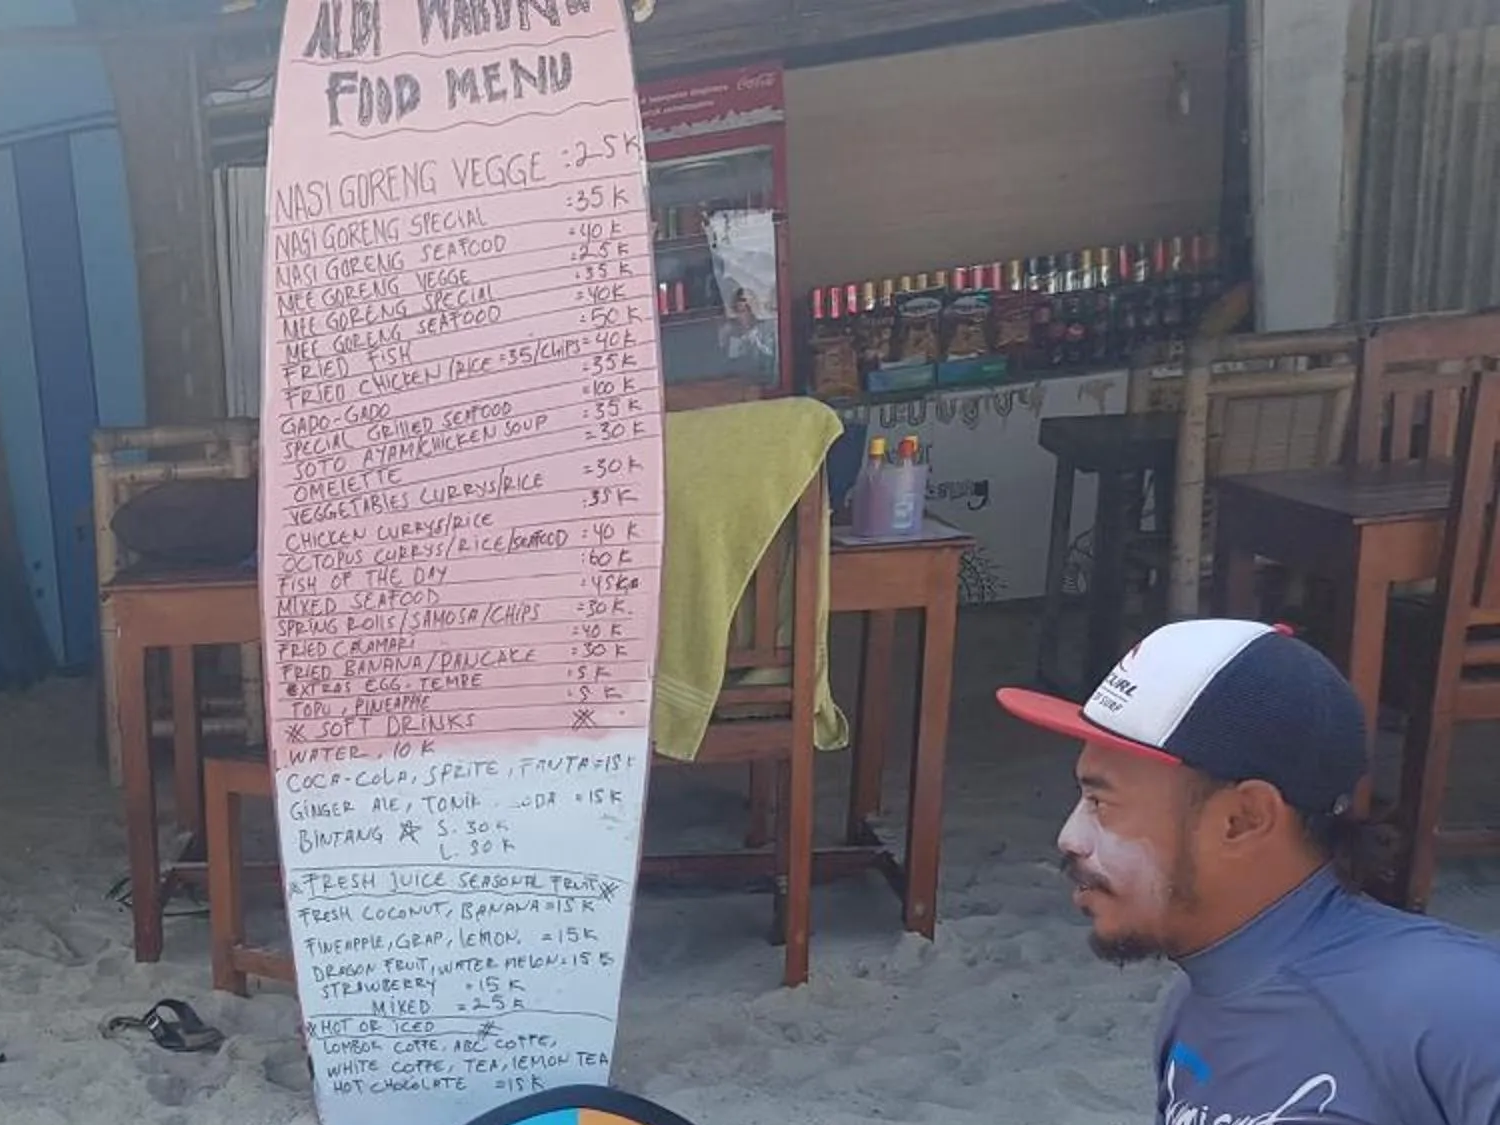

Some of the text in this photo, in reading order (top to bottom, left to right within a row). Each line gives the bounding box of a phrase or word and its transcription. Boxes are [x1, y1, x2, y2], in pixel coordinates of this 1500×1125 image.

[417, 0, 591, 47] WARUN
[325, 52, 573, 127] FOOD MENU
[275, 181, 332, 222] NASI
[339, 159, 438, 209] GORENG
[451, 151, 546, 188] VEGGE
[275, 228, 318, 262] NASI
[323, 217, 400, 253] GORENG
[408, 207, 487, 237] SPECIAL
[274, 234, 507, 290] NASI GORENG SEAFOOD
[322, 276, 399, 309] GORENG
[417, 267, 470, 293] VEGGE
[325, 299, 408, 332] GORENG
[333, 322, 401, 356] GORENG
[418, 304, 501, 337] SEAFOOD
[282, 356, 350, 388] FRIED
[366, 340, 413, 373] FISH
[284, 384, 346, 411] FRIED
[358, 362, 442, 397] CHICKEN
[293, 456, 347, 482] SOTO
[503, 413, 549, 438] SOUP
[285, 526, 368, 554] CHICKEN
[282, 548, 363, 573] OCTOPUS
[279, 572, 318, 597] FISH
[331, 570, 352, 591] OF
[364, 563, 403, 588] THE
[414, 564, 448, 586] DAY
[278, 595, 338, 618] MIXED
[349, 588, 440, 612] SEAFOOD
[278, 641, 327, 661] FRIED
[280, 662, 332, 682] FRIED
[320, 717, 372, 739] SOFT
[300, 825, 383, 854] BINTANG
[302, 872, 375, 896] FRESH
[391, 871, 444, 890] JUICE
[454, 871, 544, 889] SEASONAL
[299, 903, 353, 928] FRESH
[461, 899, 540, 922] BANANA
[321, 978, 438, 1000] STRAWBERRY
[321, 1018, 353, 1034] HOT
[326, 1058, 380, 1079] WHITE
[574, 1050, 610, 1068] TEA
[333, 1079, 364, 1096] HOT
